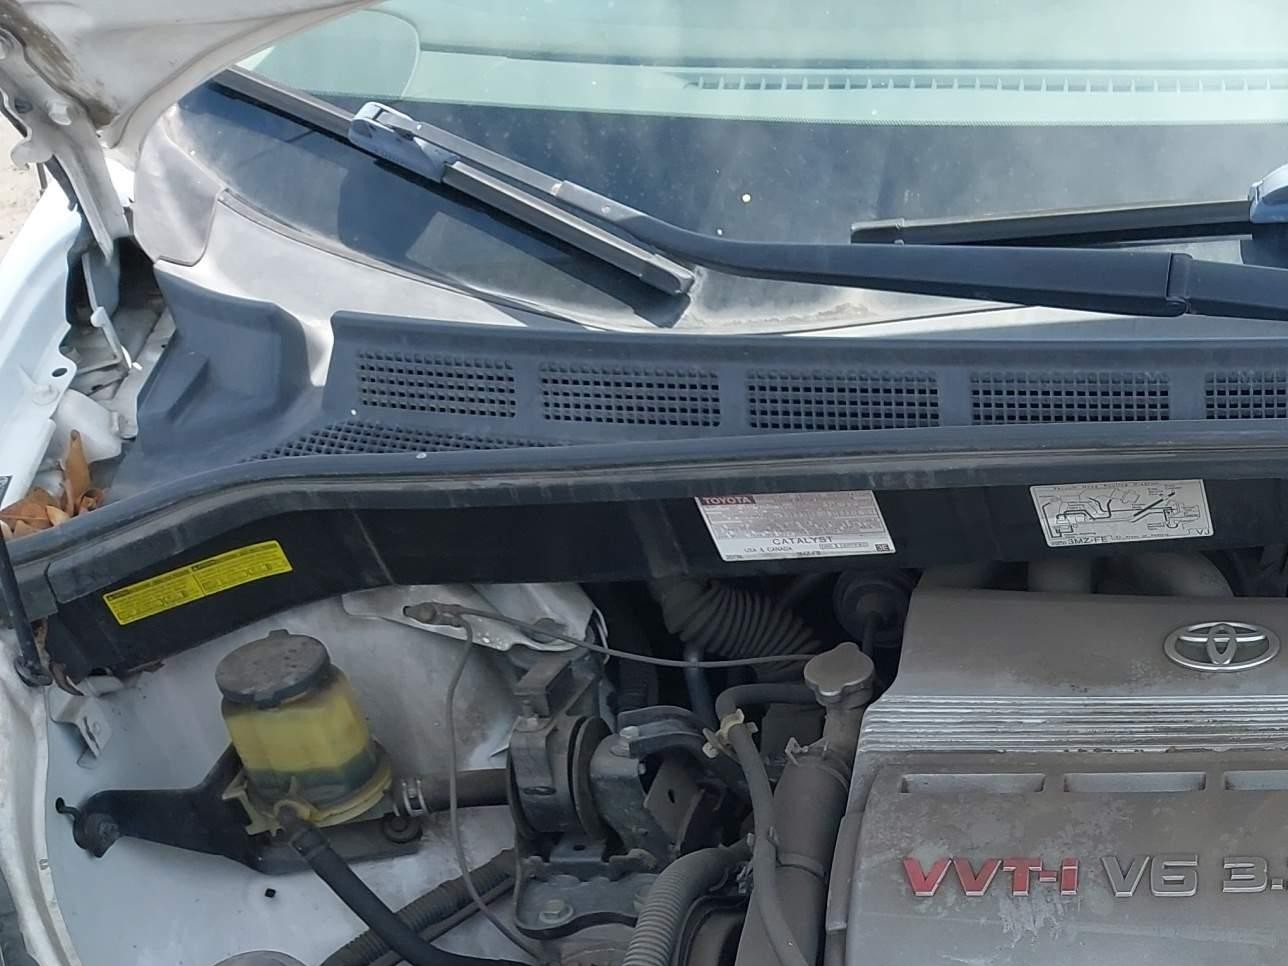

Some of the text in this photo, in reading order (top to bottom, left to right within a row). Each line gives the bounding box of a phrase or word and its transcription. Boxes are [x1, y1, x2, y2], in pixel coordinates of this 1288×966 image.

[703, 496, 752, 505] TOYOTA
[772, 535, 833, 546] CATALYST
[1102, 855, 1200, 897] V6
